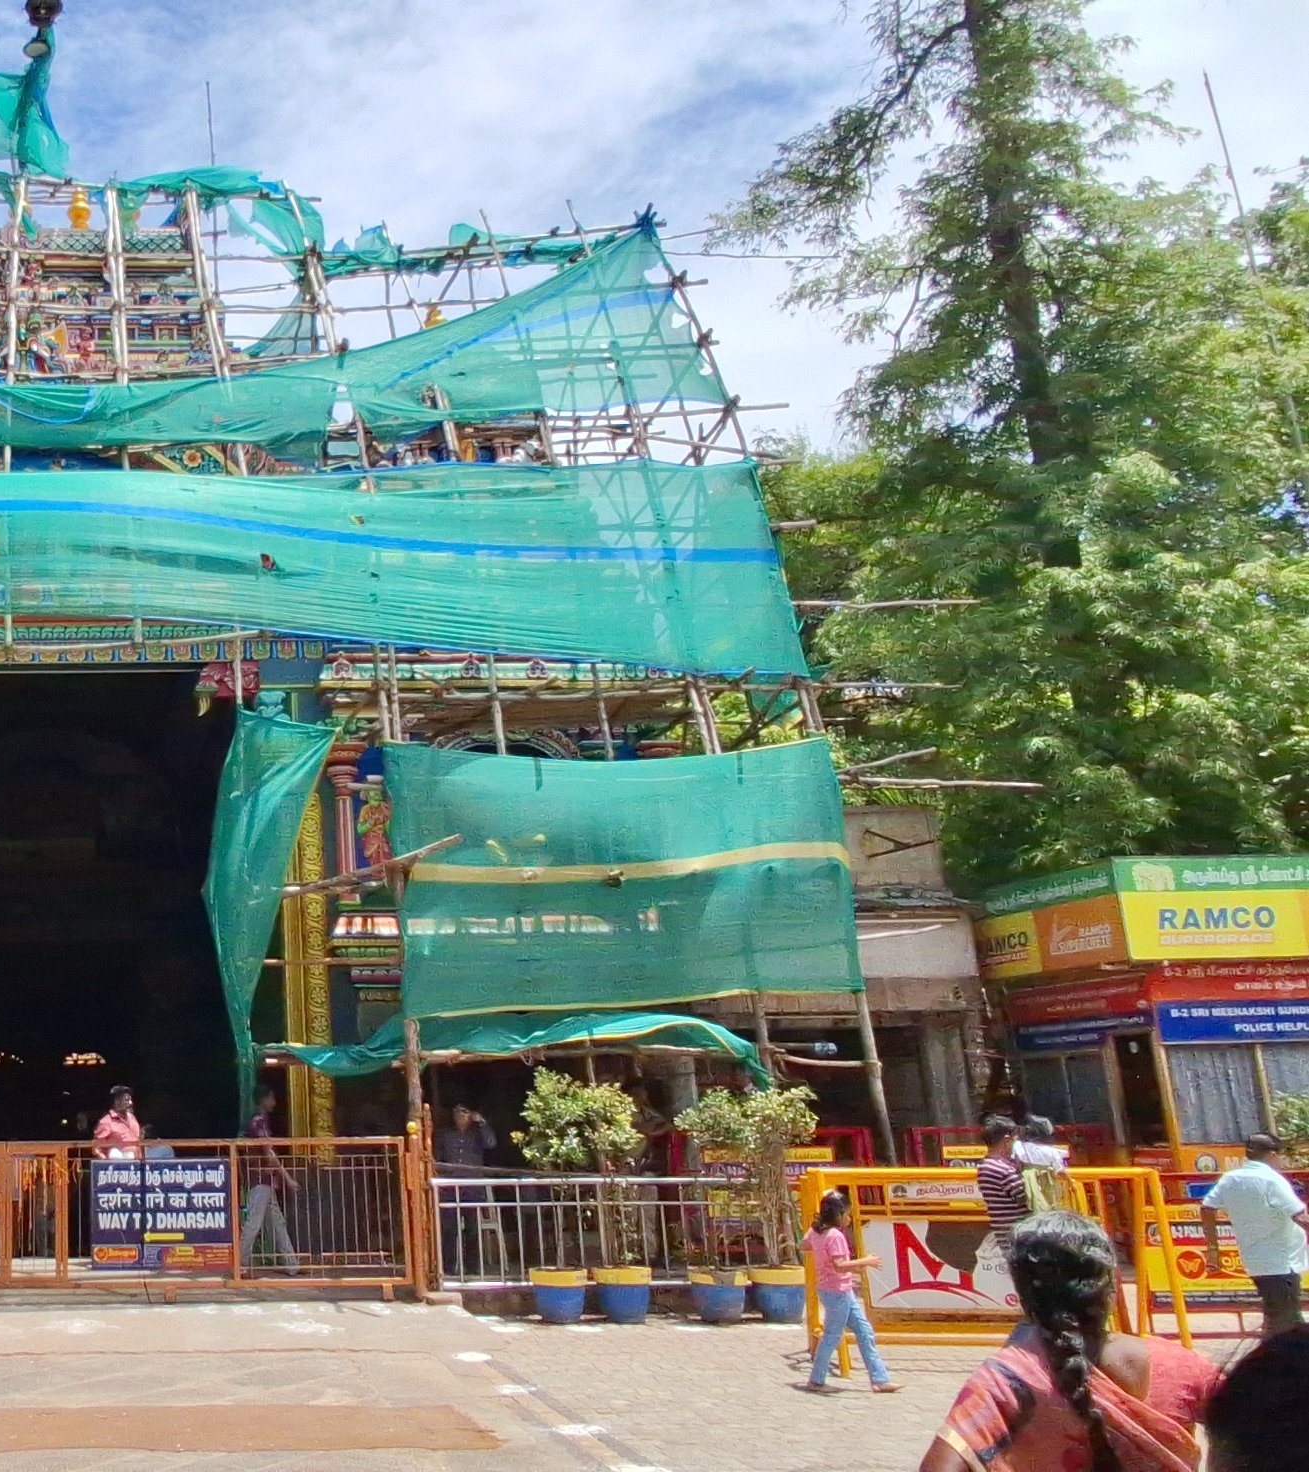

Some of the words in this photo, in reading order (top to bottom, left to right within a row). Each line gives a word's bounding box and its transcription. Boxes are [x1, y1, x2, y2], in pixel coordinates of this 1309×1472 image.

[1158, 906, 1276, 930] RAMCO
[1160, 932, 1274, 946] SUPERGRADE
[1170, 1008, 1190, 1017] B-2
[1191, 1008, 1209, 1017] SRI
[1212, 1006, 1275, 1017] MEENAKSHI
[1234, 1022, 1274, 1032] POLICE
[205, 1164, 225, 1187] வழி
[97, 1187, 132, 1210] दर्शन
[168, 1193, 188, 1208] का
[191, 1193, 225, 1209] रास्ता
[98, 1213, 130, 1230] WAY
[157, 1212, 225, 1229] DHARSAN
